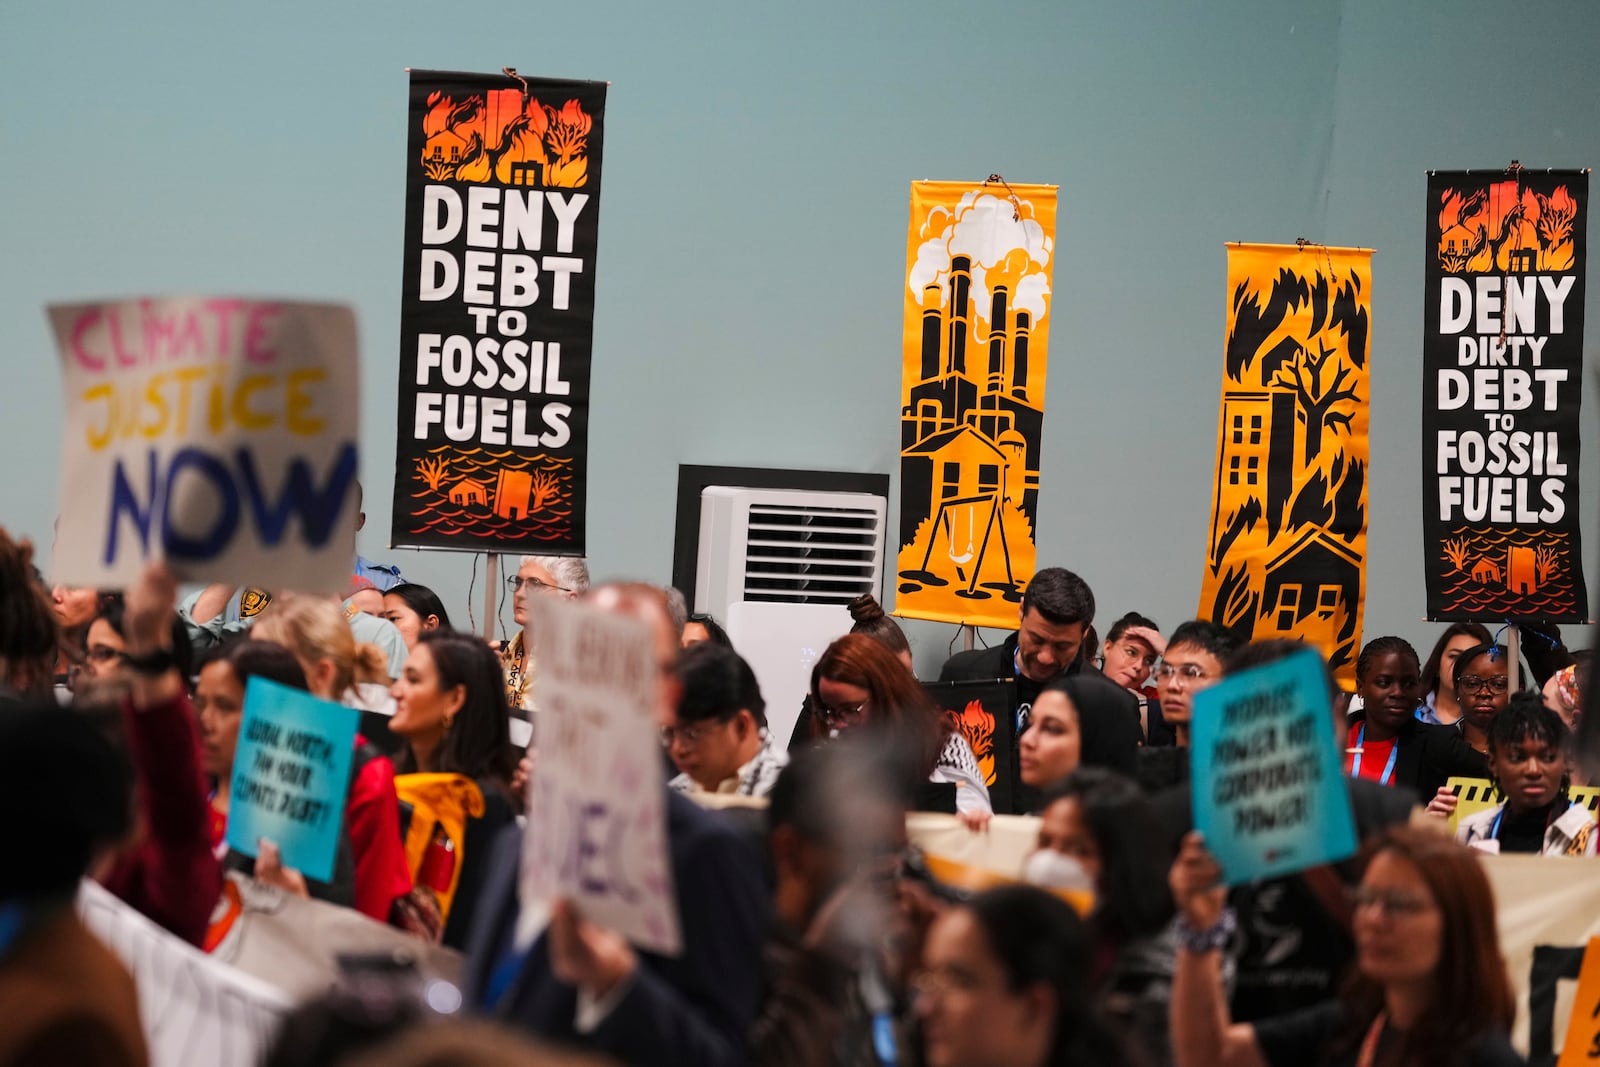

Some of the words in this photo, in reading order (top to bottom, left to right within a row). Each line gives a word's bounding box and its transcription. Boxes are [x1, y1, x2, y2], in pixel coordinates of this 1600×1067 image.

[422, 184, 590, 254] DENY
[419, 249, 584, 310] DEBT
[1439, 275, 1577, 335] DENY
[467, 306, 527, 337] TO
[416, 333, 570, 396] FOSSIL
[1458, 336, 1548, 367] DIRTY
[1437, 368, 1569, 411] DEBT
[414, 392, 572, 449] FUELS
[1484, 413, 1515, 432] TO
[1437, 430, 1568, 476] FOSSIL
[104, 438, 358, 566] NOW
[1438, 476, 1565, 524] FUELS
